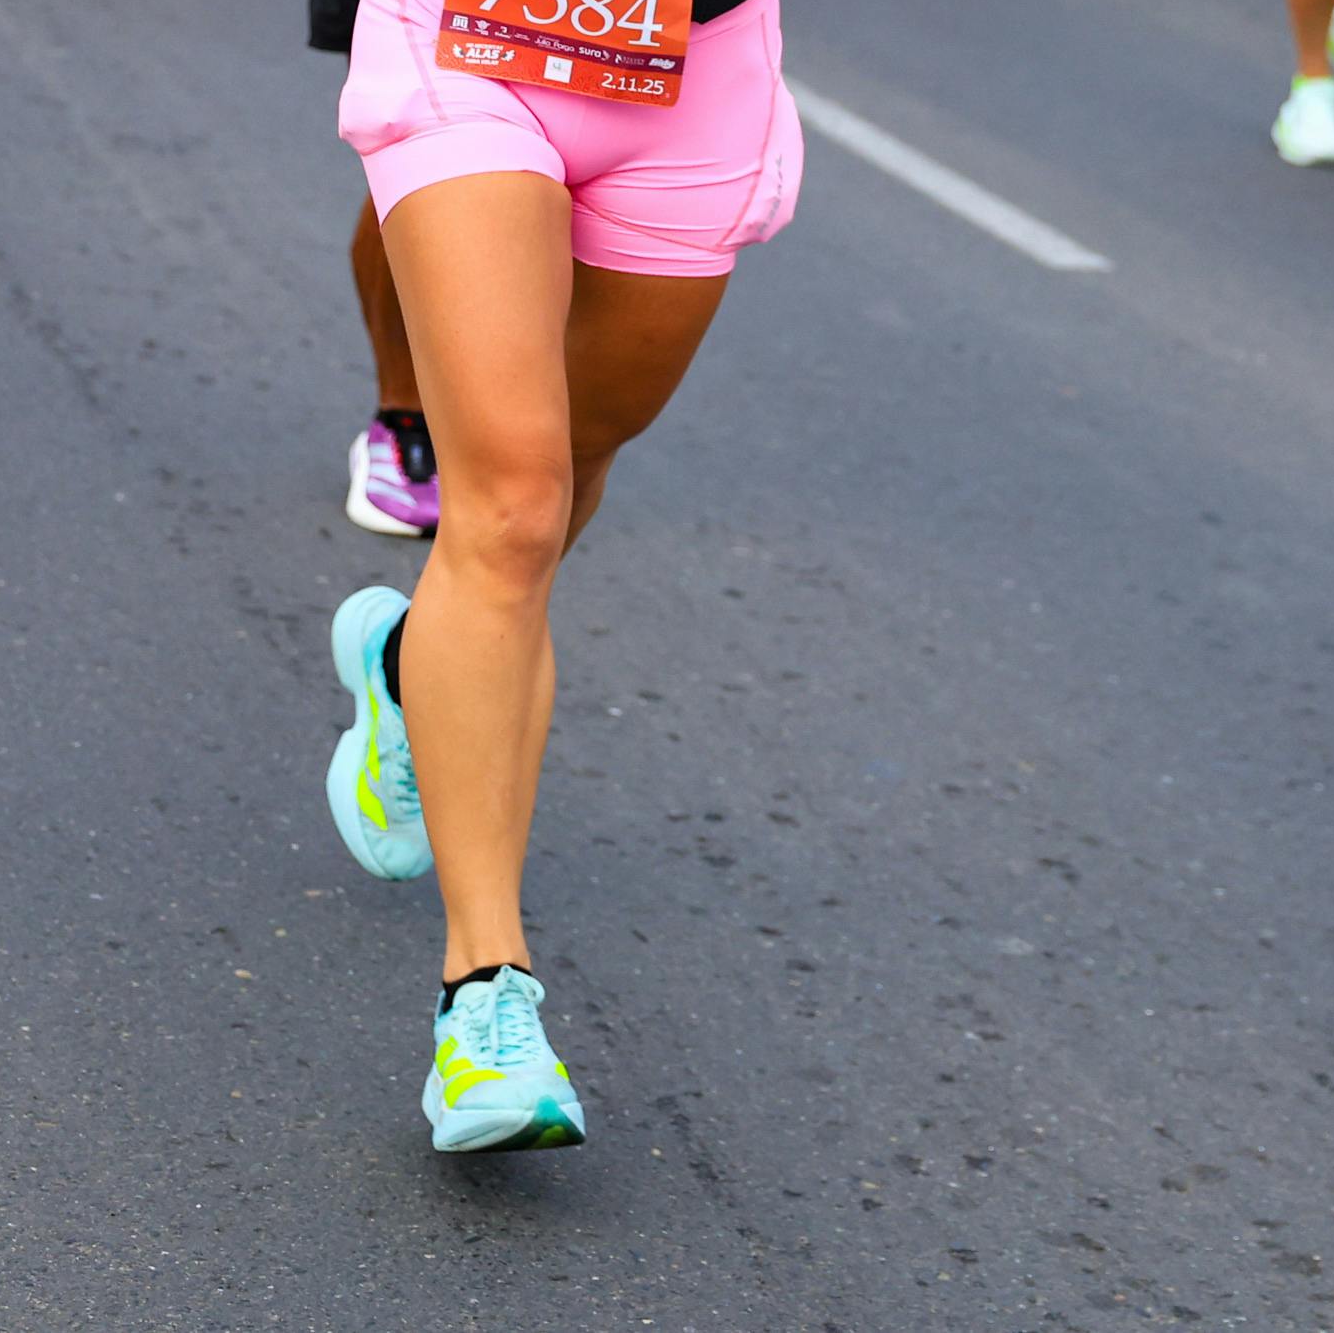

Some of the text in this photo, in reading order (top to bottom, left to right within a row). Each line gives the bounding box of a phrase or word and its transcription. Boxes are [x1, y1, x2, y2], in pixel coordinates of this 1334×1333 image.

[465, 48, 500, 60] ALAS
[578, 46, 602, 58] sura
[601, 73, 665, 96] 2.11.25
